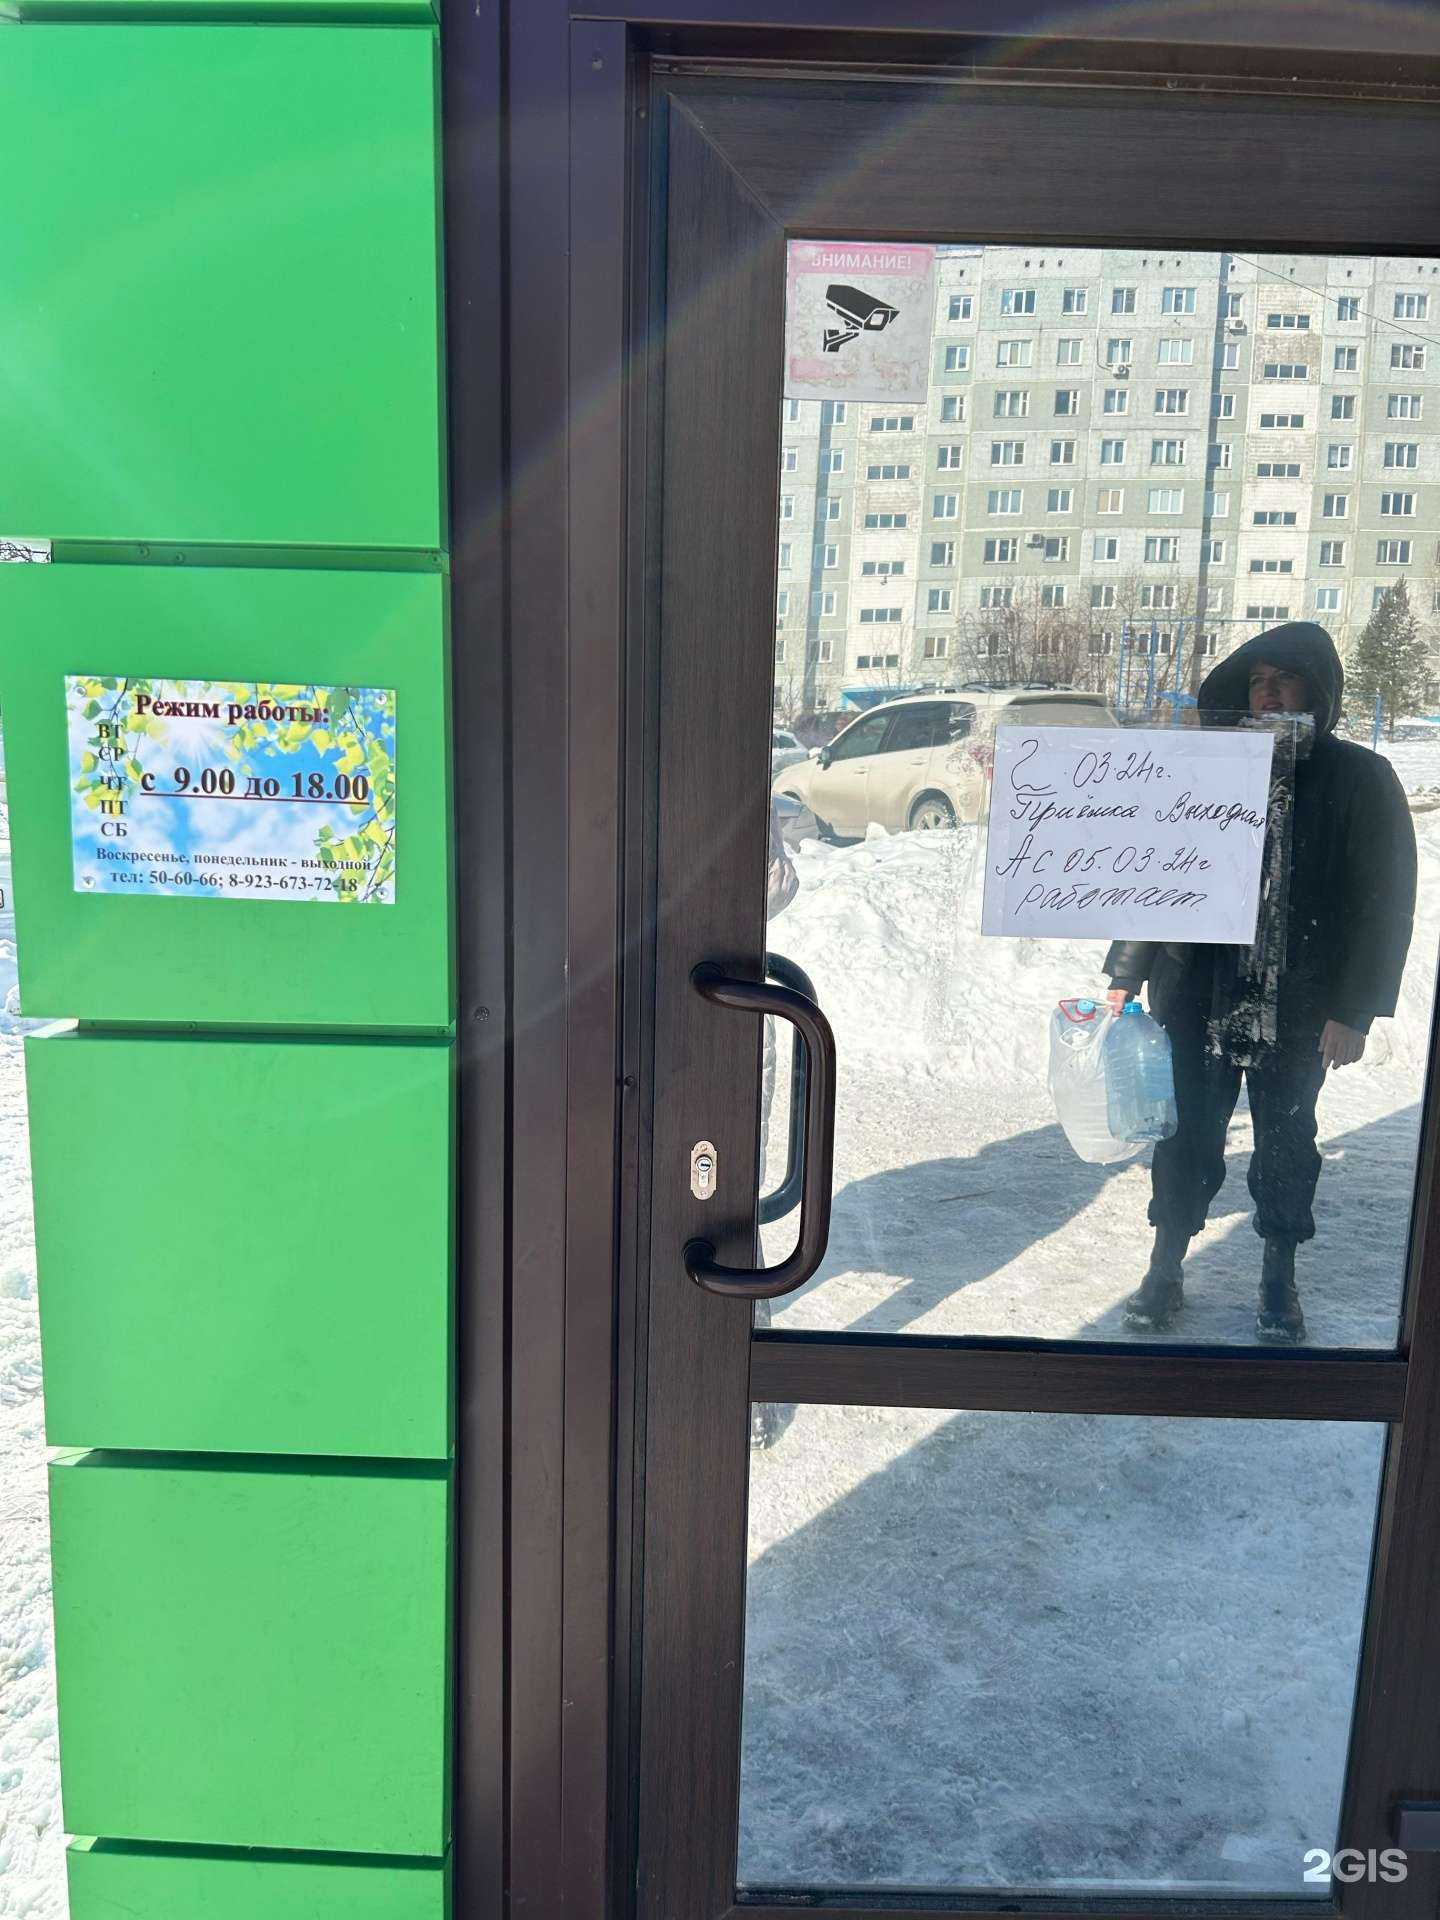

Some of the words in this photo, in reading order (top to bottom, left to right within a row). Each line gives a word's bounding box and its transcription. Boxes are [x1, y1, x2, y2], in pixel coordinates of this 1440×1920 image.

[135, 694, 220, 718] Режим
[228, 700, 330, 724] работы:
[98, 723, 124, 739] ВТ
[98, 747, 125, 761] СР
[99, 775, 127, 791] ЧТ
[140, 772, 155, 791] с
[174, 766, 236, 794] 9.00
[244, 776, 280, 799] до
[291, 772, 370, 801] 18.00
[100, 799, 129, 816] ПТ
[100, 822, 128, 838] СБ
[96, 847, 190, 865] Воскресенье,
[193, 854, 288, 868] понедельник
[301, 857, 372, 871] выходной
[110, 872, 144, 885] тел:
[149, 870, 224, 889] 50-60-66;
[229, 873, 358, 892] 8-923-673-72-18
